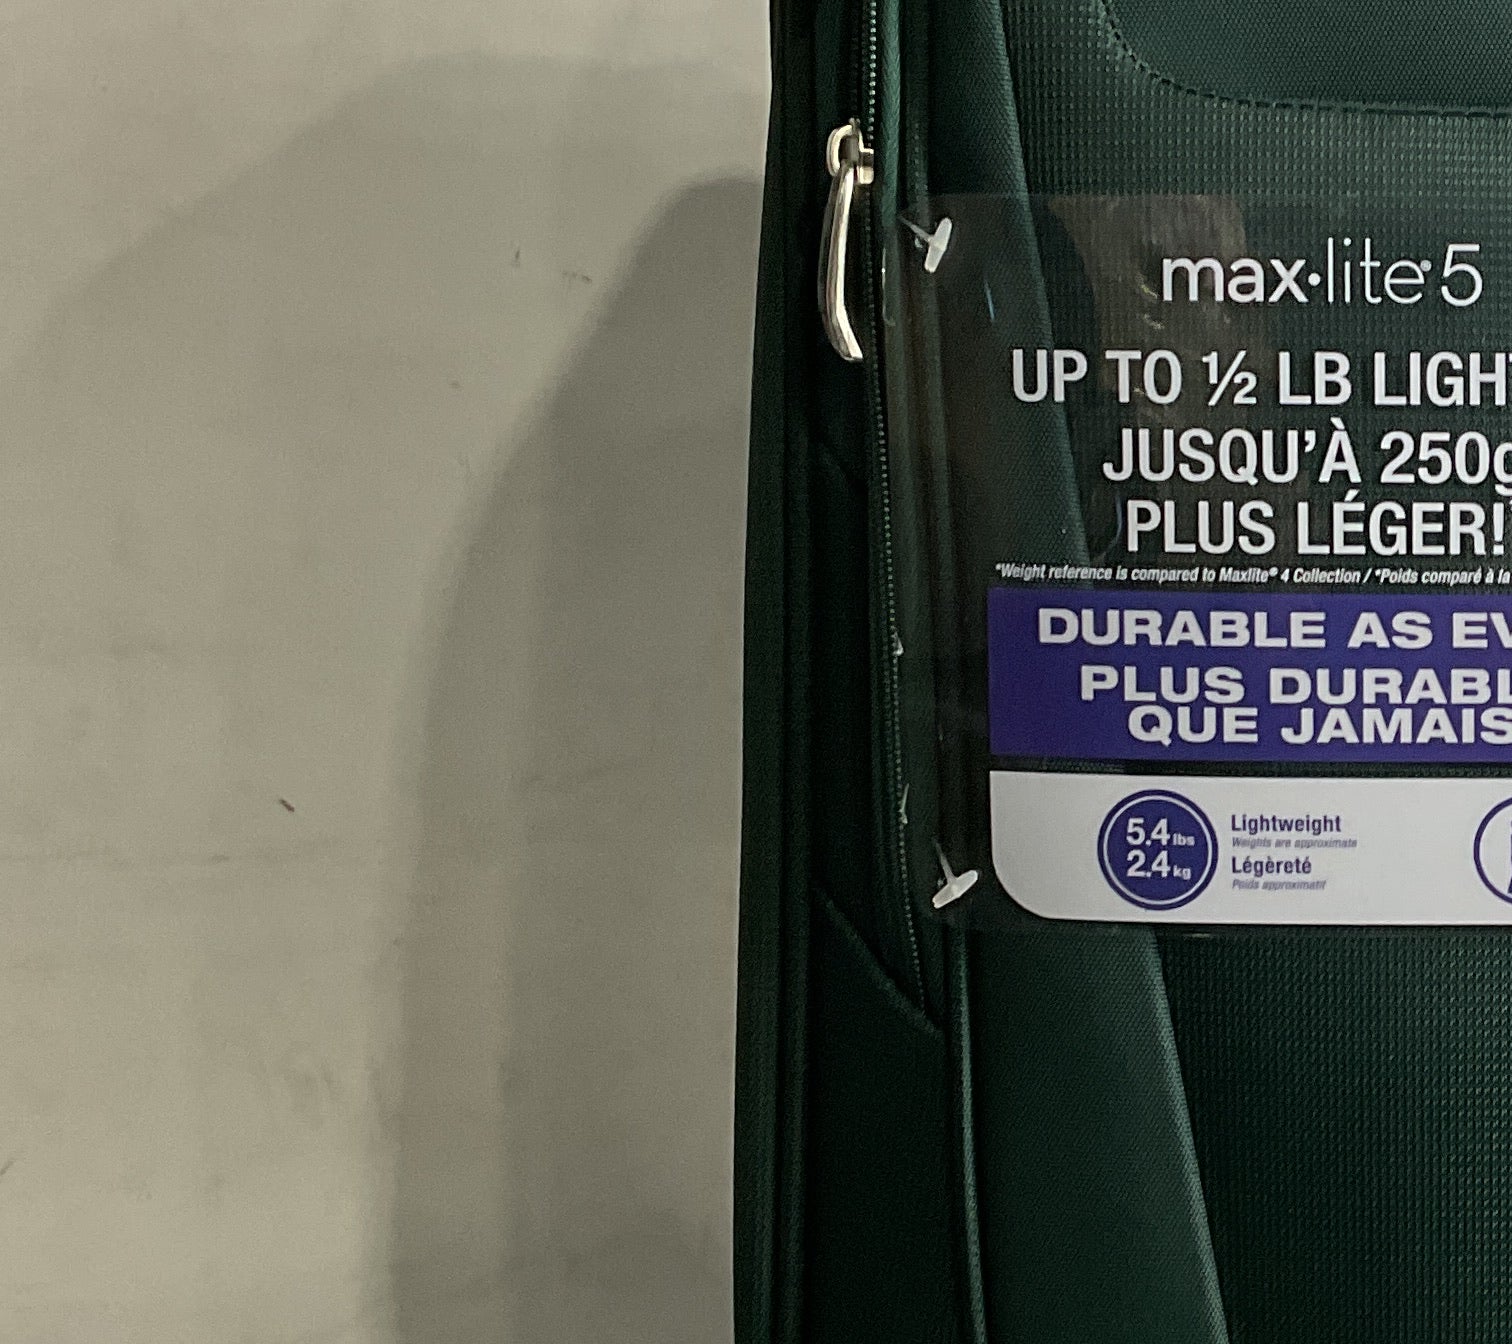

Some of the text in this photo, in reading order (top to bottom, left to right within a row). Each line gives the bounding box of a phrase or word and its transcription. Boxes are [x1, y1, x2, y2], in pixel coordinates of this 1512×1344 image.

[1011, 349, 1088, 403] UP
[1105, 350, 1182, 405] TO
[1278, 352, 1352, 405] LB
[1127, 501, 1275, 554] PLUS
[1048, 564, 1113, 581] reference
[1116, 565, 1128, 581] is
[1131, 566, 1199, 585] compared
[1201, 567, 1216, 581] to
[1280, 568, 1290, 583] 4
[1293, 567, 1361, 584] Collection
[1421, 567, 1482, 587] comparé
[1484, 567, 1495, 585] à
[1498, 568, 1511, 585] la
[1038, 607, 1326, 649] DURABLE
[1348, 612, 1432, 649] AS
[1080, 664, 1245, 705] PLUS
[1127, 707, 1260, 745] QUE
[1126, 817, 1195, 846] 5.4 lbs
[1231, 814, 1342, 835] Lightweight
[1231, 836, 1358, 849] Weights are approximate
[1126, 850, 1192, 881] 2.4 kg
[1231, 856, 1312, 877] Légèreté
